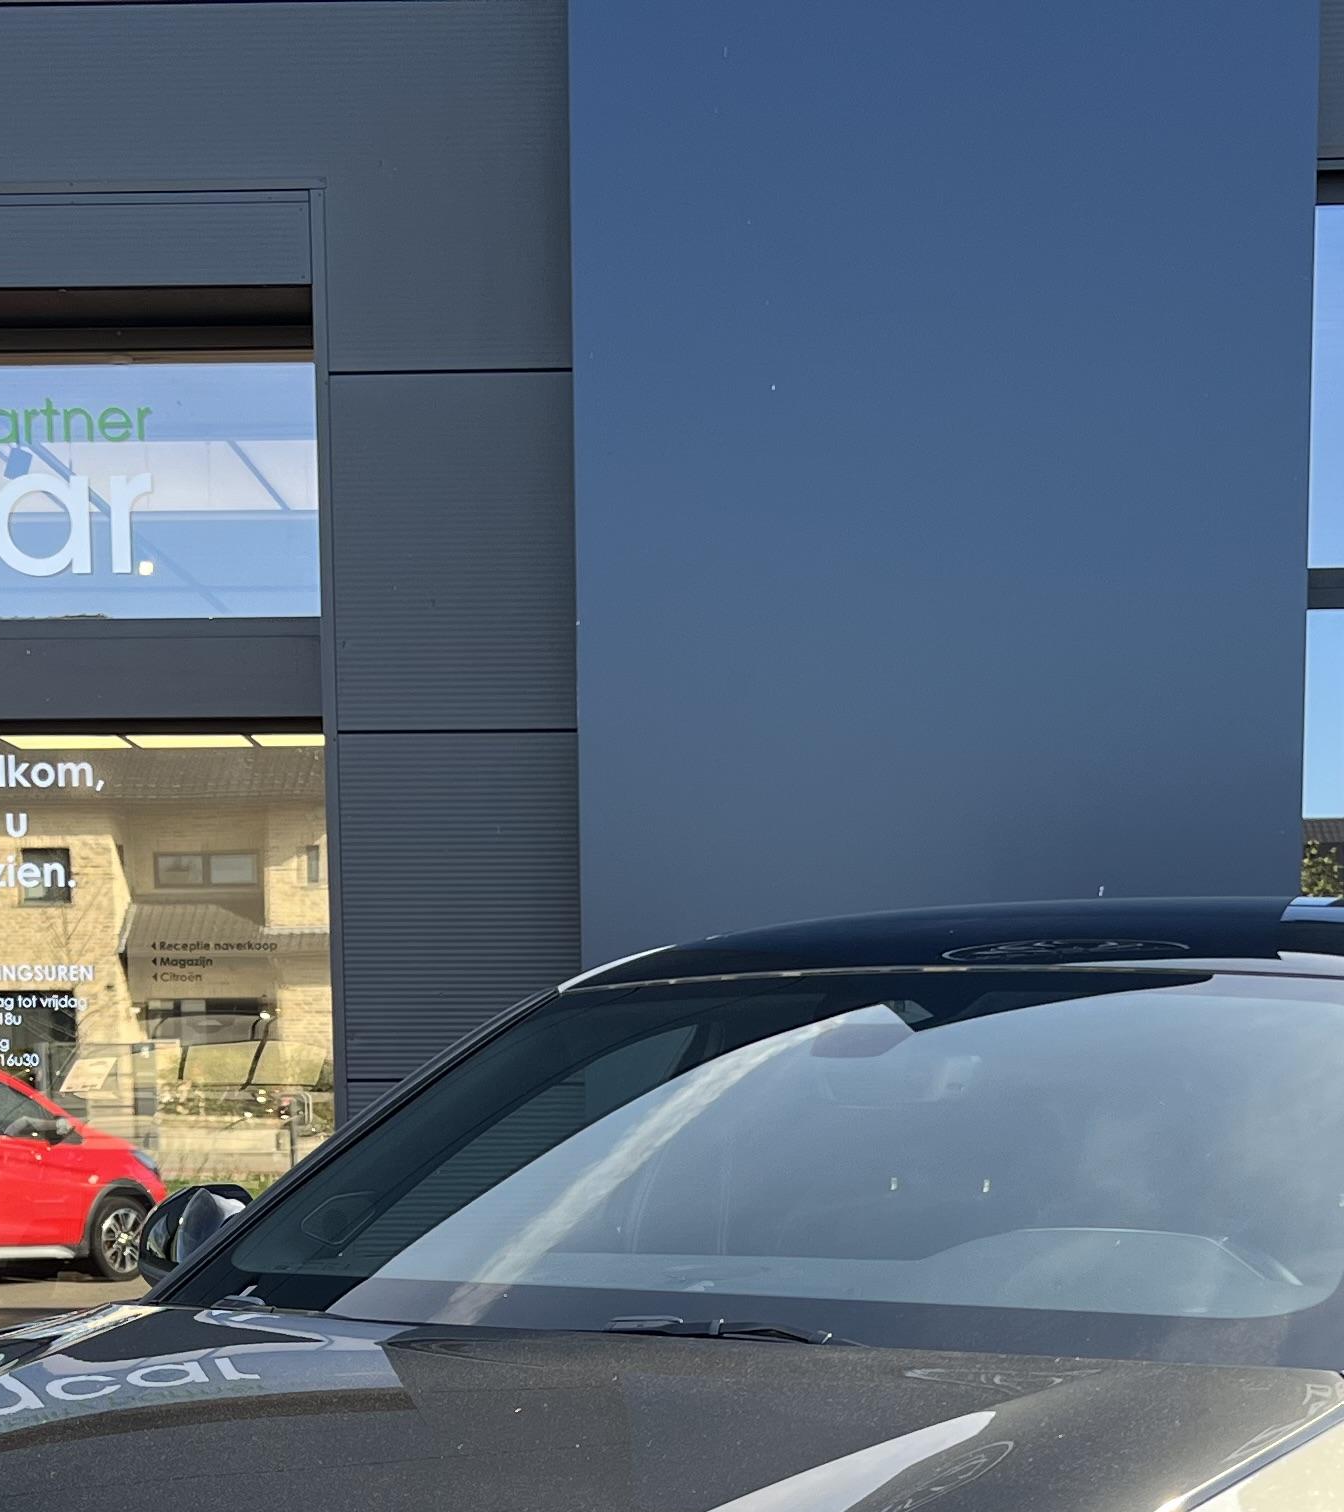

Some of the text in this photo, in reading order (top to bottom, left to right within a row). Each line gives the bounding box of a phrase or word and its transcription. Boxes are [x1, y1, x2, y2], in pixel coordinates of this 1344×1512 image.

[6, 813, 28, 838] u
[159, 940, 277, 953] Receptie naverkoop
[159, 957, 213, 968] Magazijn
[18, 996, 36, 1009] tot
[39, 995, 87, 1011] vrijdag
[0, 1053, 39, 1067] 16u30
